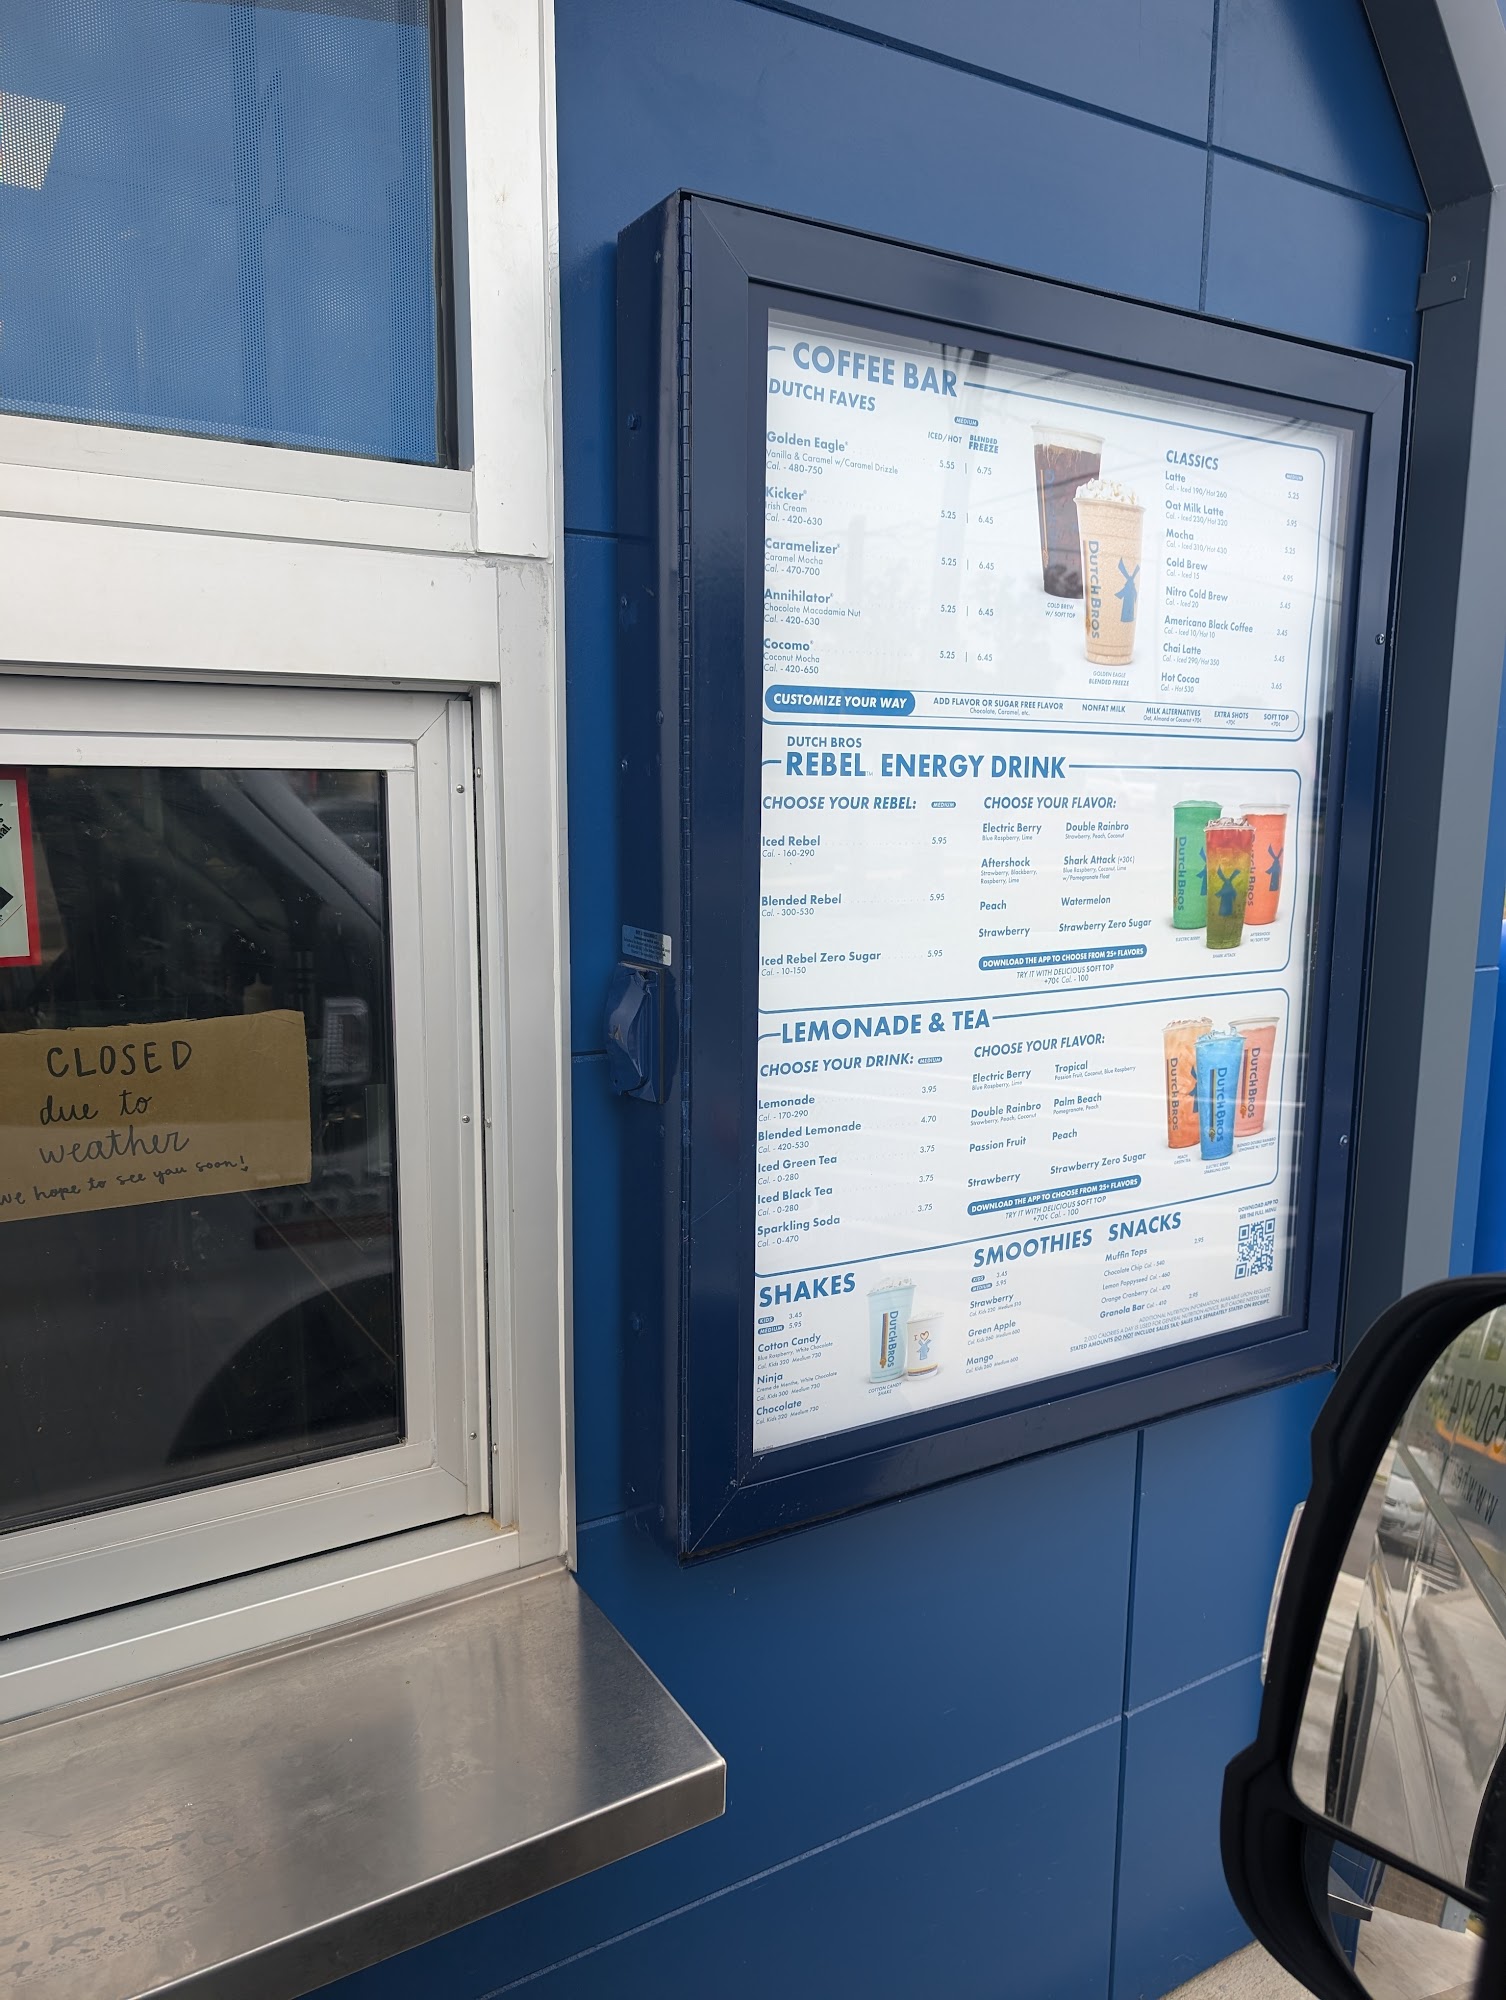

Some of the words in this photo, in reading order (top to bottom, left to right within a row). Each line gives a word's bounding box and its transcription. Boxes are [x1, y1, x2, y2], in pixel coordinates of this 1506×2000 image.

[793, 342, 895, 385] COFFEE
[903, 362, 957, 398] BAR
[769, 378, 825, 402] DUTCH
[830, 390, 876, 412] FAVES
[767, 431, 811, 448] Golden
[928, 431, 962, 444] ICED/HOT
[969, 435, 998, 445] BLENDED
[969, 441, 999, 454] FREEZE
[940, 460, 955, 470] 5.55
[1166, 450, 1219, 470] CLASSICS
[766, 461, 782, 471] Cal.
[788, 464, 823, 475] 480-750
[977, 465, 992, 475] 6.75
[1165, 471, 1186, 483] Latte
[1165, 500, 1181, 510] Oat
[1184, 502, 1201, 513] Milk
[1203, 505, 1224, 517] Latte
[941, 511, 956, 520] 5.25
[978, 515, 994, 525] 6.45
[1166, 528, 1194, 540] Mocha
[765, 553, 796, 563] Caramel
[797, 555, 823, 565] Mocha
[941, 557, 957, 567] 5.25
[1166, 557, 1184, 568] Cold
[1187, 560, 1208, 570] Brew
[979, 562, 994, 570] 6.45
[1165, 586, 1187, 598] Nitro
[1189, 589, 1206, 600] Cold
[1208, 591, 1228, 602] Brew
[764, 603, 801, 613] Chocolate
[802, 606, 846, 616] Macadamia
[848, 609, 861, 617] Nut
[941, 605, 956, 613] 5.25
[978, 608, 994, 617] 6.45
[1165, 615, 1206, 628] Americano
[1208, 620, 1228, 630] Black
[1230, 622, 1253, 633] Coffee
[1163, 642, 1180, 653] Chai
[1182, 644, 1201, 655] Latte
[940, 651, 955, 660] 5.25
[977, 654, 993, 662] 6.45
[1161, 672, 1175, 682] Hot
[1177, 674, 1200, 684] Cocoa
[774, 694, 842, 706] CUSTOMIZE
[844, 696, 878, 708] YOUR
[880, 697, 907, 709] WAY
[1082, 704, 1109, 712] NONFAT
[1146, 707, 1160, 715] MILK
[1162, 708, 1200, 716] ALTERNATIVES
[787, 736, 828, 748] DUTCH
[830, 737, 862, 748] BROS
[882, 754, 984, 778] ENERGY
[991, 755, 1066, 778] DRINK
[763, 796, 826, 810] CHOOSE
[829, 796, 871, 810] YOUR
[874, 796, 916, 810] REBEL:
[984, 796, 1034, 809] CHOOSE
[1037, 797, 1069, 809] YOUR
[1072, 797, 1117, 809] FLAVOR:
[983, 823, 1015, 833] Electric
[1017, 823, 1042, 834] Berry
[1066, 822, 1095, 831] Double
[1098, 822, 1129, 831] Rainbro
[762, 836, 785, 846] Iced
[788, 835, 820, 846] Rebel
[932, 837, 946, 845] 5.95
[981, 857, 1031, 868] Aftershock
[1064, 856, 1088, 865] Shark
[1090, 854, 1116, 864] Attack
[762, 894, 807, 906] Blended
[810, 894, 842, 905] Rebel
[980, 900, 1007, 910] Peach
[1061, 895, 1110, 907] Watermelon
[1059, 921, 1106, 932] Strawberry
[1108, 920, 1127, 929] Zero
[1129, 918, 1152, 929] Sugar
[978, 926, 1030, 938] Strawberry
[762, 954, 783, 966] Iced
[787, 953, 817, 964] Rebel
[820, 953, 845, 963] Zero
[849, 952, 881, 963] Sugar
[782, 1014, 922, 1044] LEMONADE
[928, 1012, 945, 1032] &
[952, 1009, 990, 1032] TEA
[974, 1042, 1023, 1058] CHOOSE
[1026, 1038, 1058, 1051] YOUR
[1061, 1033, 1105, 1048] FLAVOR:
[46, 1040, 192, 1078] CLOSED
[760, 1060, 818, 1077] CHOOSE
[823, 1055, 861, 1071] YOUR
[866, 1052, 914, 1067] DRINK:
[1055, 1061, 1088, 1073] Tropical
[758, 1094, 815, 1110] Lemonade
[1053, 1098, 1075, 1107] Palm
[1077, 1093, 1102, 1104] Beach
[40, 1095, 98, 1126] due
[119, 1090, 152, 1116] to
[921, 1115, 937, 1123] 4.70
[758, 1126, 802, 1141] Blended
[805, 1120, 862, 1136] Lemonade
[1052, 1129, 1078, 1140] Peach
[39, 1124, 190, 1164] weather
[920, 1145, 935, 1153] 3.75
[969, 1141, 1003, 1153] Passion
[1006, 1137, 1026, 1147] Fruit
[758, 1162, 780, 1173] Iced
[783, 1158, 816, 1170] Green
[819, 1155, 837, 1165] Tea
[0, 1192, 26, 1206] we
[34, 1178, 81, 1201] hope
[88, 1176, 106, 1191] to
[116, 1171, 146, 1186] see
[196, 1155, 248, 1172] soon!
[968, 1173, 1020, 1188] Strawberry
[758, 1193, 780, 1204] Iced
[783, 1189, 812, 1201] Black
[814, 1186, 833, 1196] Tea
[917, 1204, 933, 1212] 3.75
[757, 1220, 810, 1236] Sparkling
[813, 1215, 841, 1227] Soda
[1108, 1212, 1182, 1242] SNACKS
[973, 1228, 1092, 1268] SMOOTHIES
[1105, 1250, 1130, 1262] Muffin
[1131, 1247, 1148, 1257] Tops
[759, 1272, 856, 1308] SHAKES
[1099, 1307, 1131, 1319] Granola
[1132, 1302, 1146, 1312] Bar
[788, 1321, 802, 1329] 5.95
[968, 1327, 992, 1337] Green
[994, 1320, 1016, 1332] Apple
[758, 1341, 789, 1353] Cotton
[791, 1333, 821, 1346] Candy
[966, 1353, 994, 1366] Mango
[758, 1373, 783, 1385] Ninja
[756, 1400, 802, 1416] Chocolate
